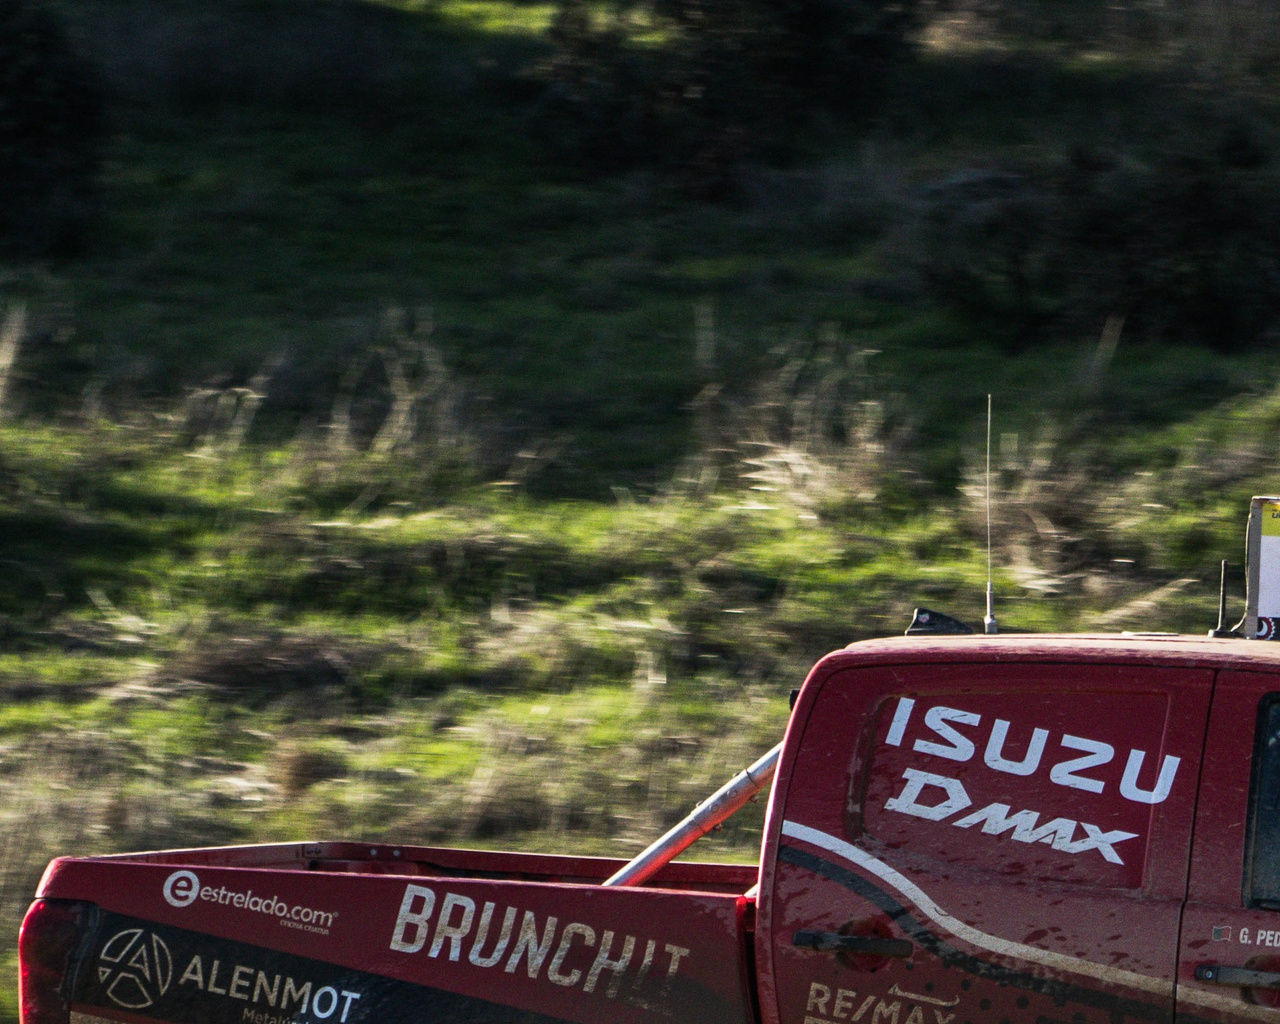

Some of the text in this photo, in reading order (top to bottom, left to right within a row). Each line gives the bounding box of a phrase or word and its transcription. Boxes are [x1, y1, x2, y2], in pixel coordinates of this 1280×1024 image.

[885, 697, 1181, 804] ISUZU
[200, 885, 333, 927] estrelado.com
[1239, 927, 1252, 945] G.
[178, 954, 361, 1024] ALENMOT
